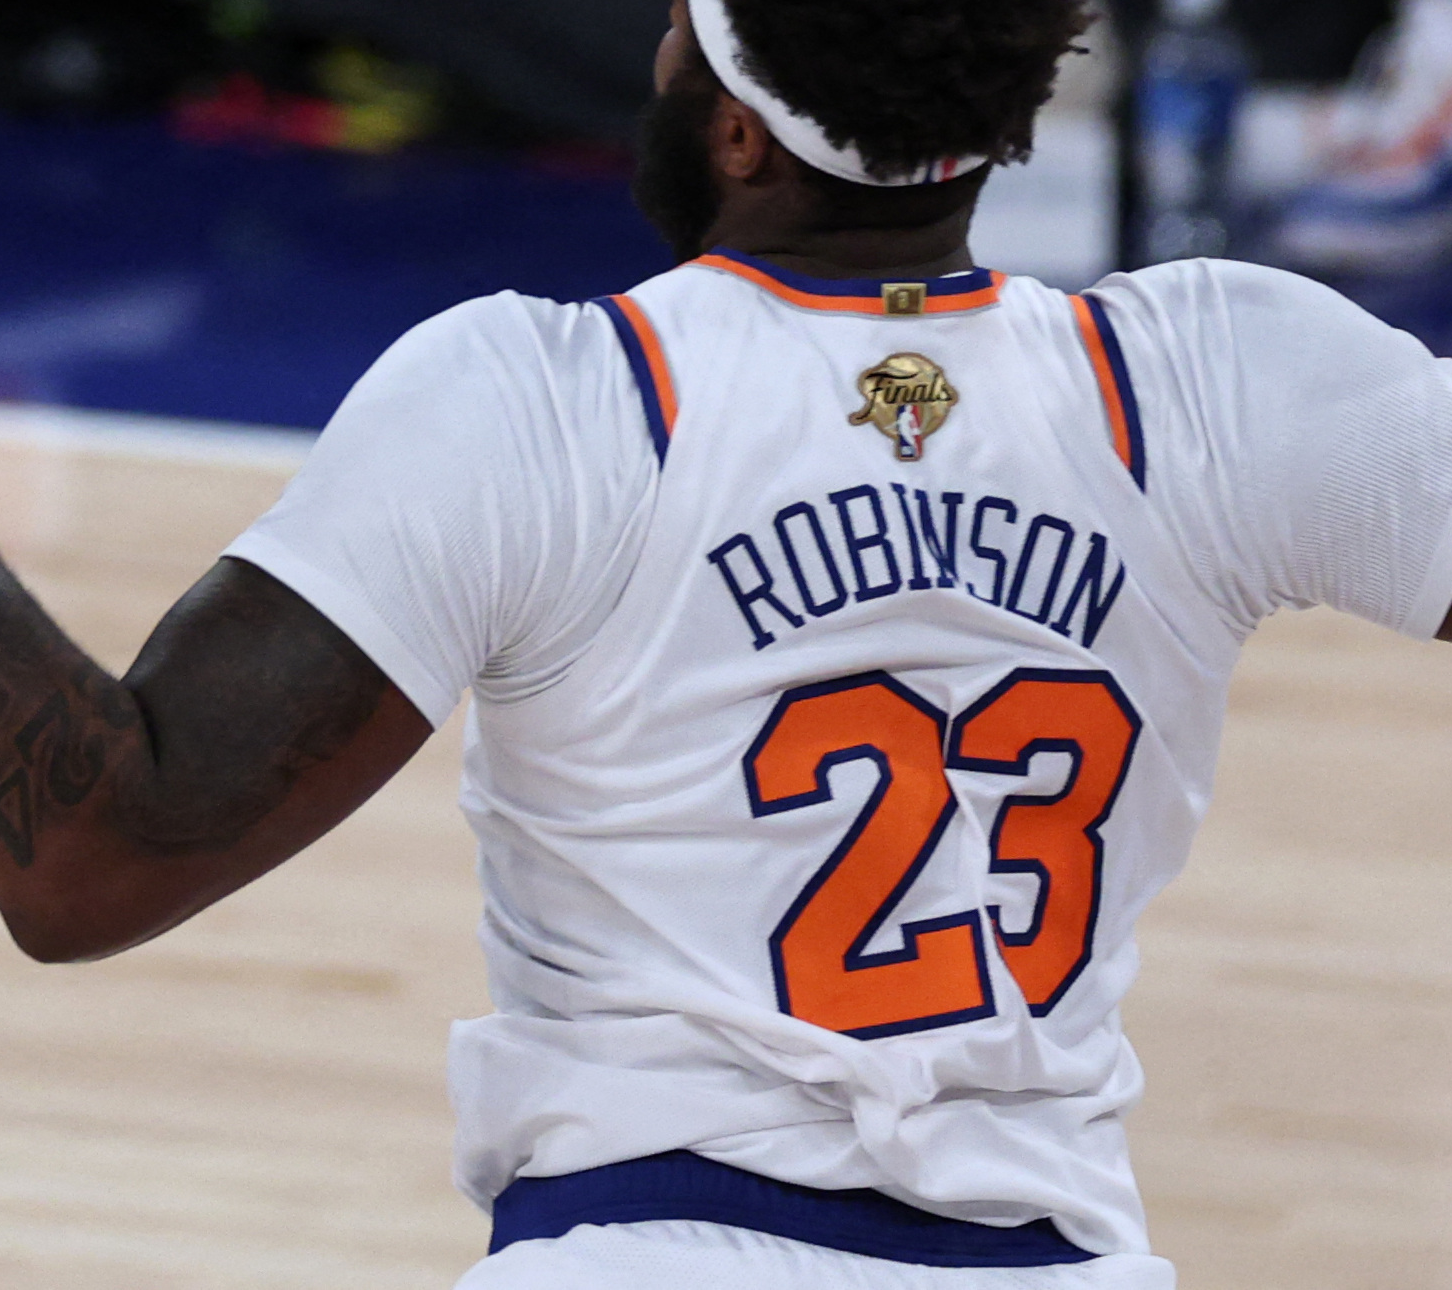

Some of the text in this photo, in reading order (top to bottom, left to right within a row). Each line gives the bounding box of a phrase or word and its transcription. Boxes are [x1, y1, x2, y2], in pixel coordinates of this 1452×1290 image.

[855, 370, 954, 421] Finals
[707, 481, 1129, 652] ROBINSON
[743, 666, 1144, 1042] 23
